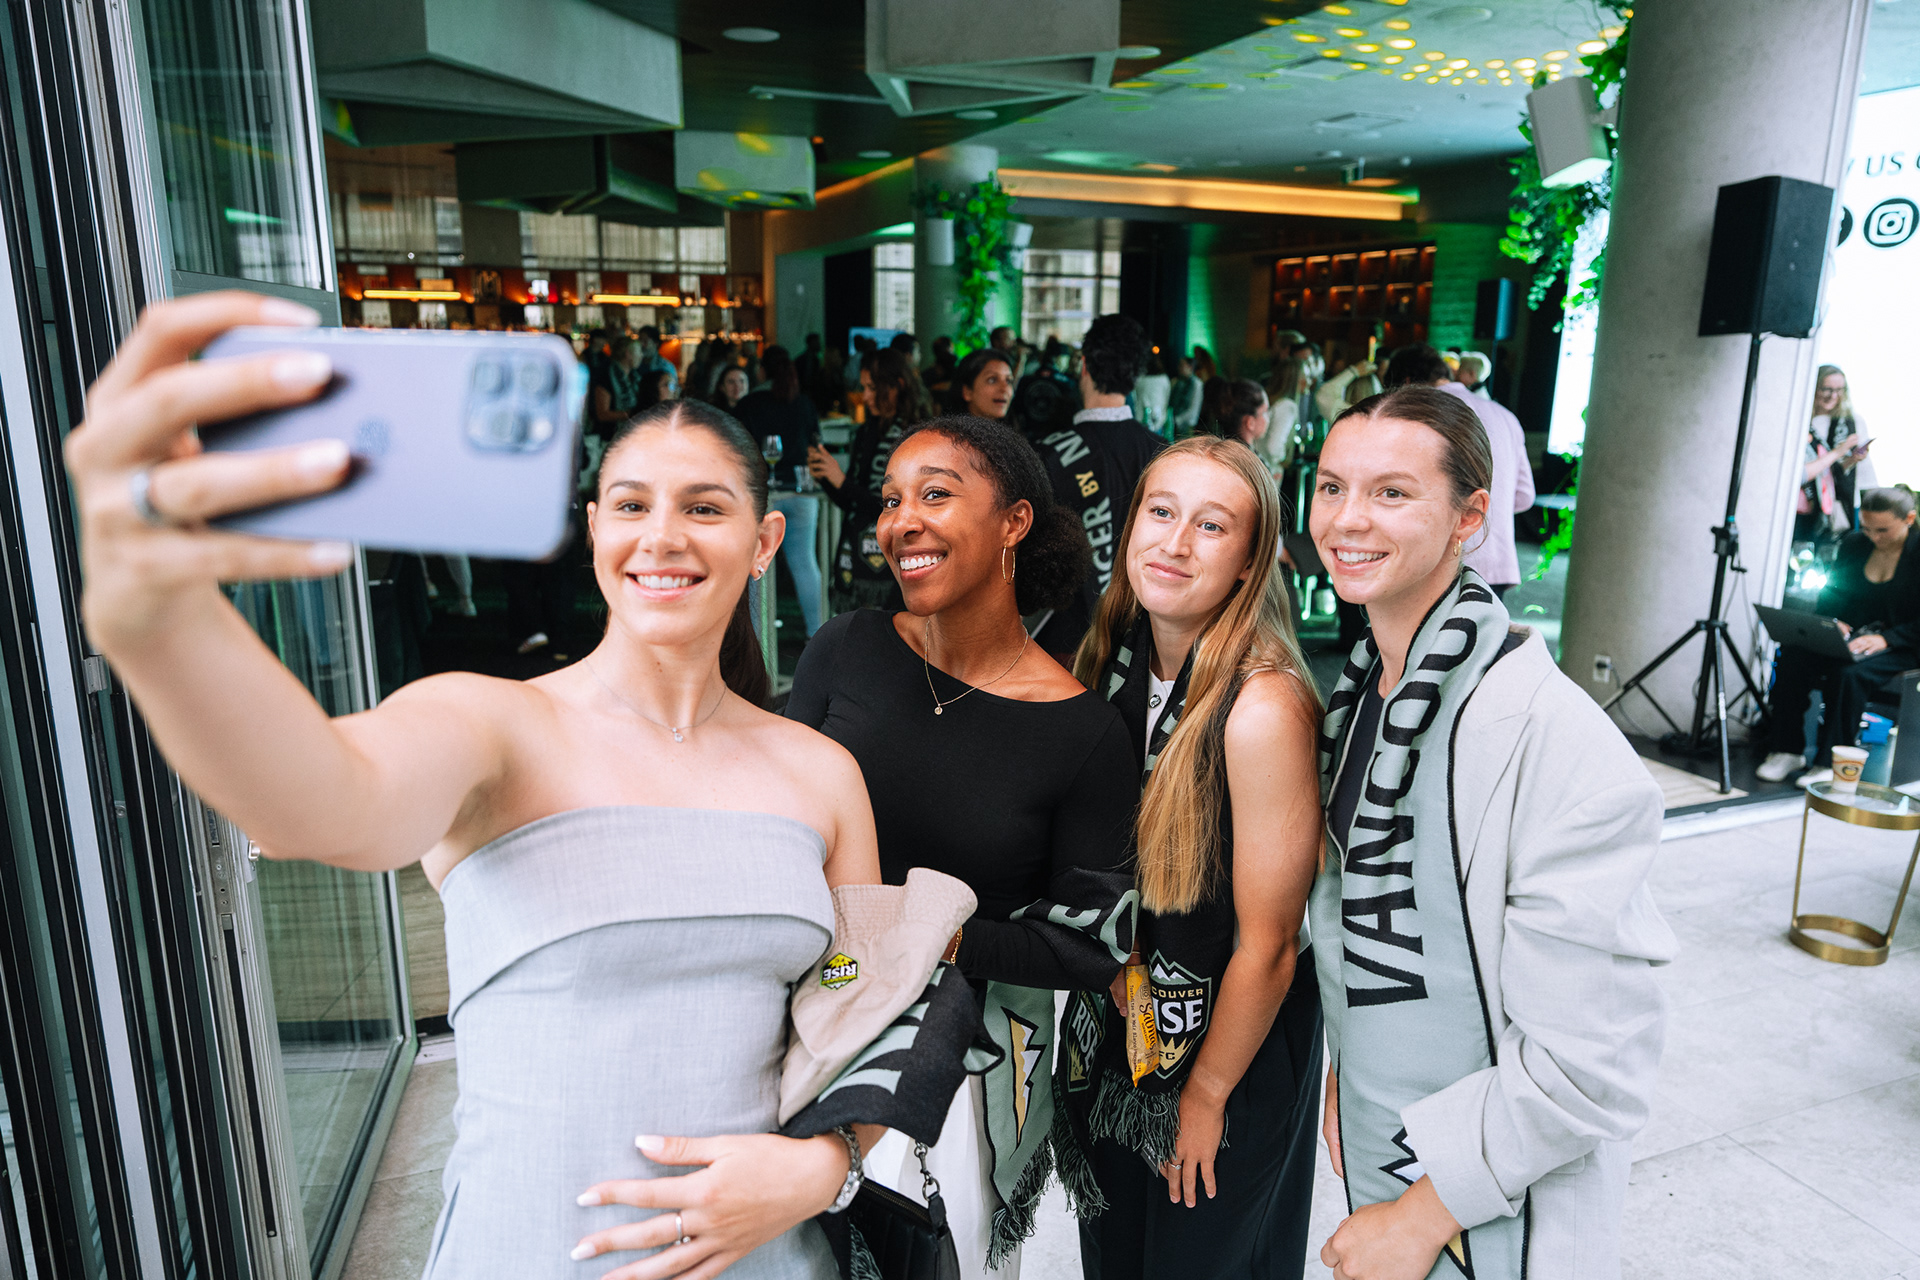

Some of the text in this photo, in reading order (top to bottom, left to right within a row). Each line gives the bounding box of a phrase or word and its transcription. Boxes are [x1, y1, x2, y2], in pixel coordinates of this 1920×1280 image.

[1866, 152, 1905, 178] US
[1075, 470, 1100, 498] BY
[1341, 566, 1493, 1008] VANCOUV
[823, 964, 857, 980] RISE
[1151, 988, 1203, 998] COUVER
[1152, 998, 1203, 1033] ISE
